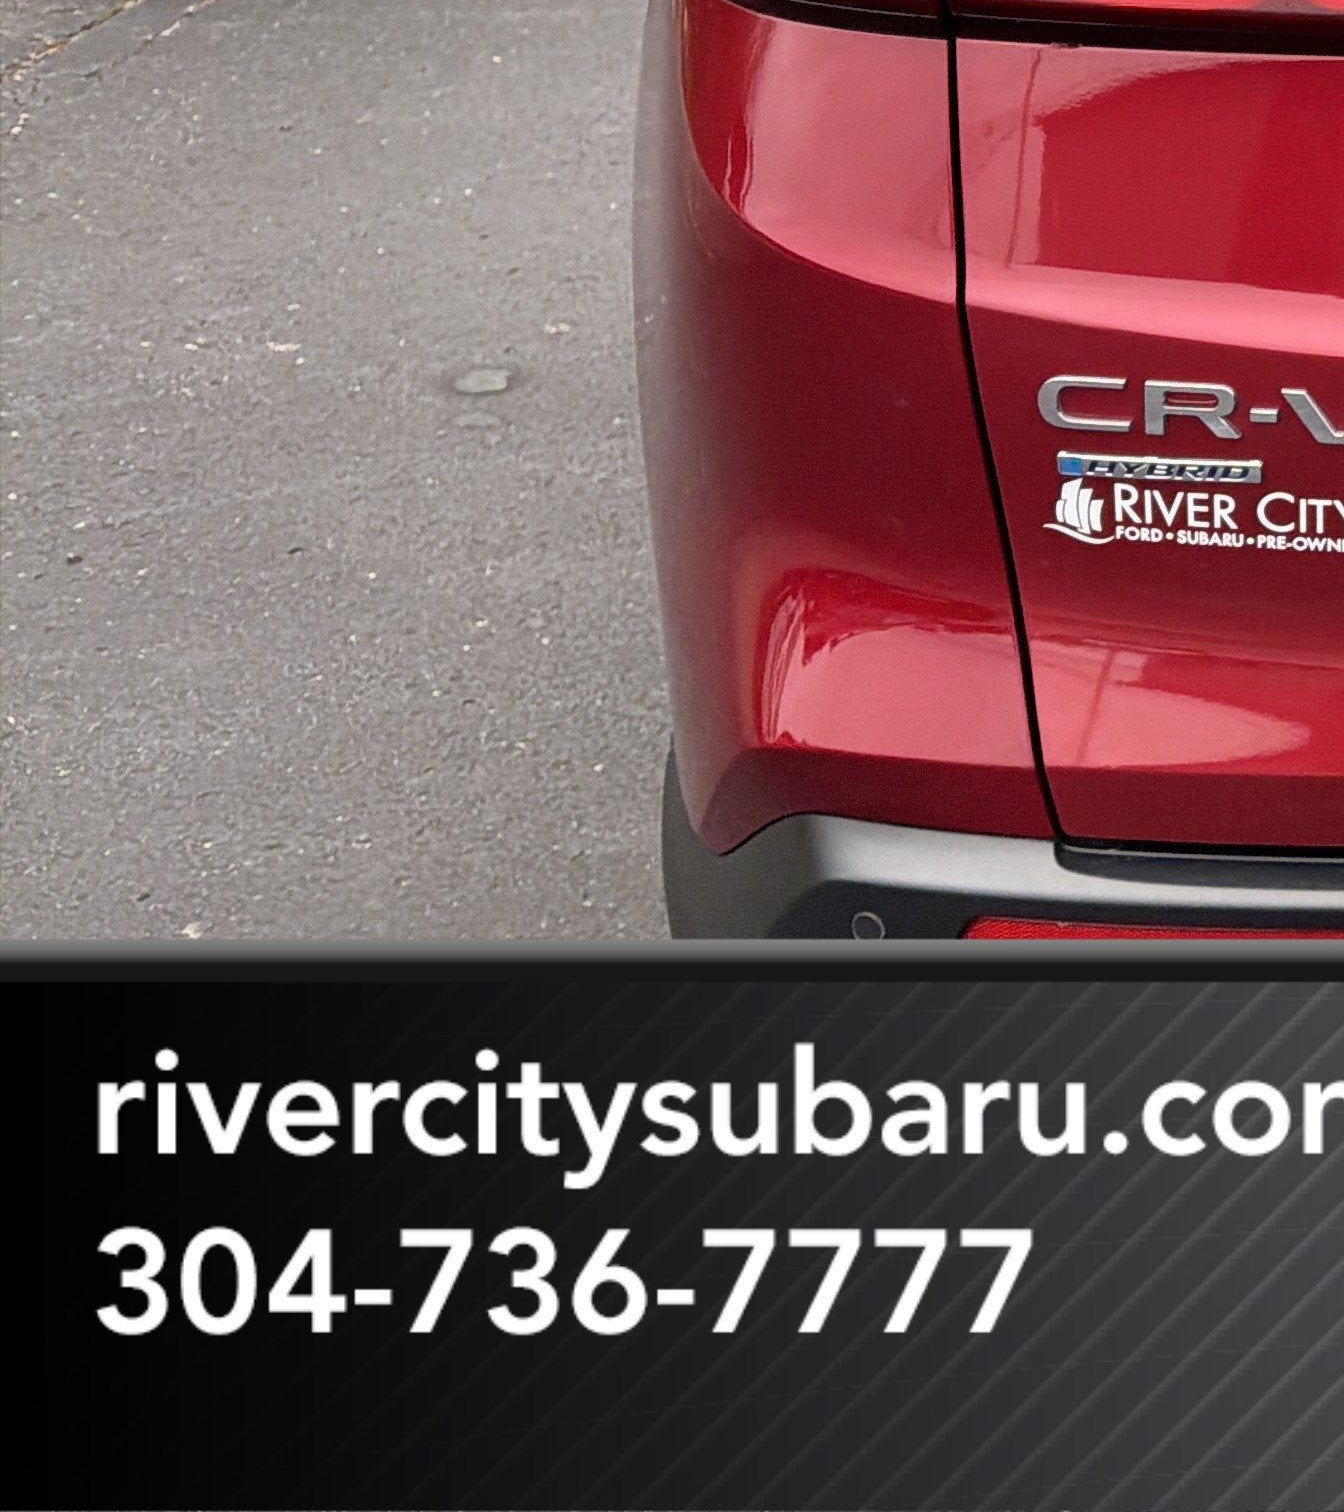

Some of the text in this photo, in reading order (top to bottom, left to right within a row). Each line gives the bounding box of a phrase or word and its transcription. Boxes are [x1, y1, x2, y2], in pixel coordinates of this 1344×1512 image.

[1086, 461, 1251, 482] HYBRID
[1113, 482, 1239, 530] RIVER
[1114, 525, 1164, 544] FORD
[1176, 528, 1245, 549] SUBARU
